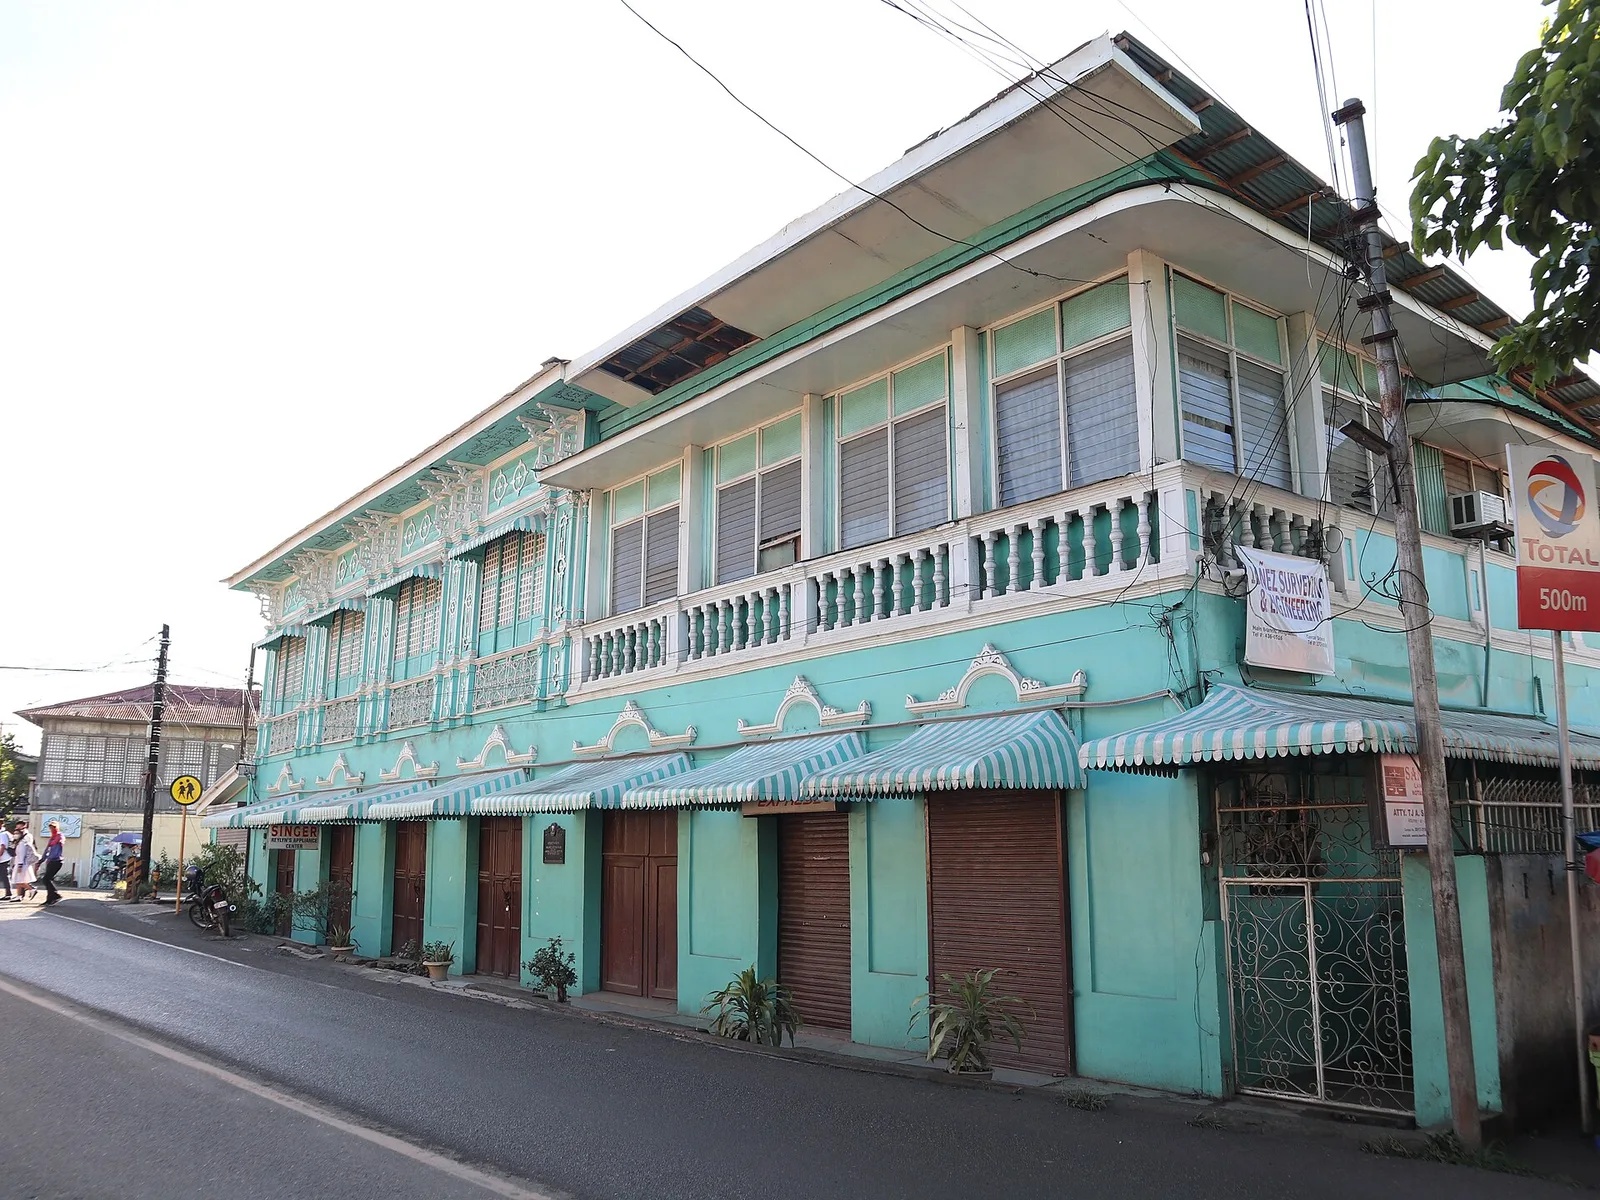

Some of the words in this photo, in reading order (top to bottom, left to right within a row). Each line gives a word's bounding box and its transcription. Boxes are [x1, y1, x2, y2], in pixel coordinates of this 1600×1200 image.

[1522, 538, 1599, 566] TOTAL
[1260, 588, 1268, 613] &
[1540, 588, 1586, 611] 500m
[271, 825, 317, 837] SINGER
